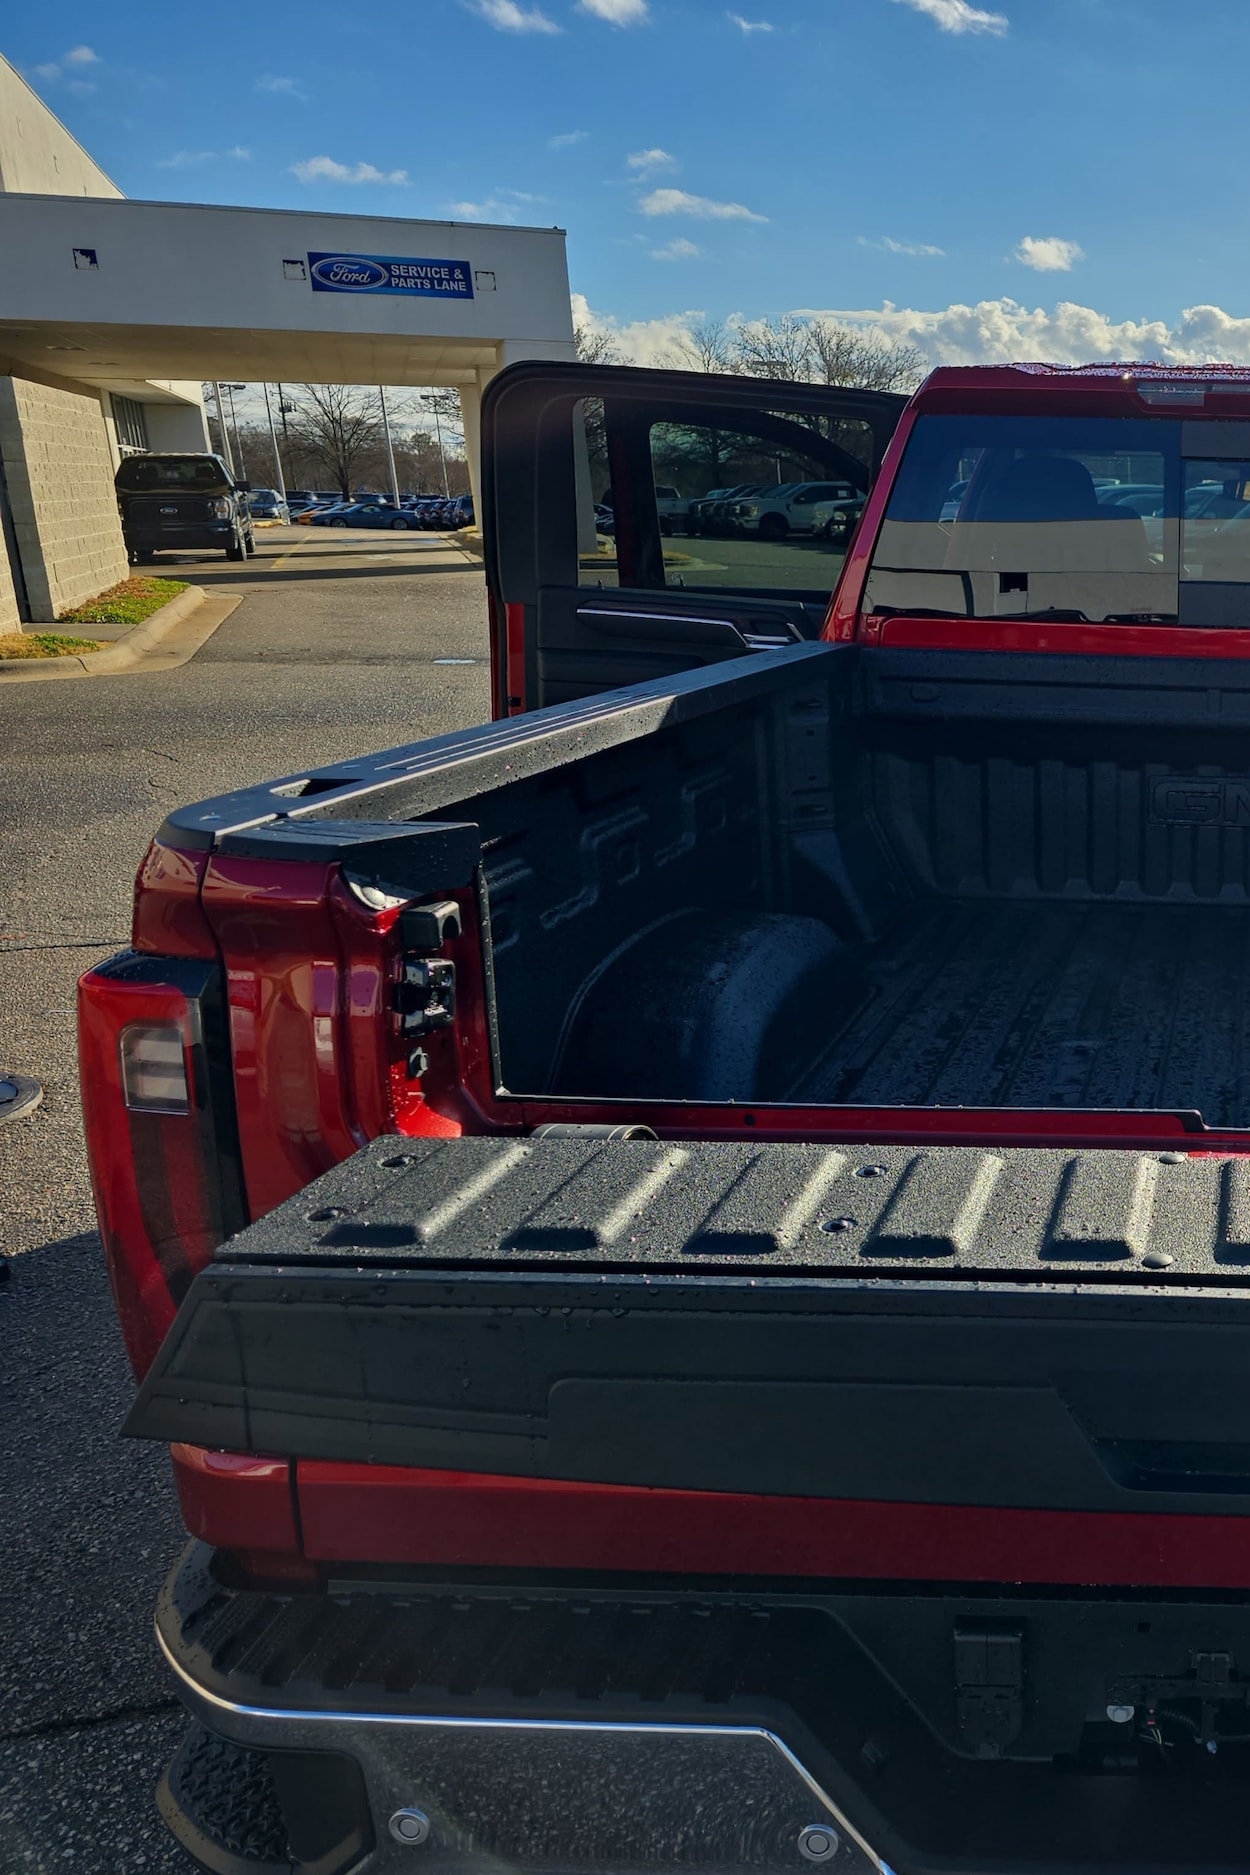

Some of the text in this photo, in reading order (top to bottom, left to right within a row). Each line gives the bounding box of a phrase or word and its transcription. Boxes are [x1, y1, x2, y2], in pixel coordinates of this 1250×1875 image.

[329, 263, 371, 284] Ford
[390, 264, 464, 280] SERVICE &
[391, 277, 467, 292] PARTS LANE
